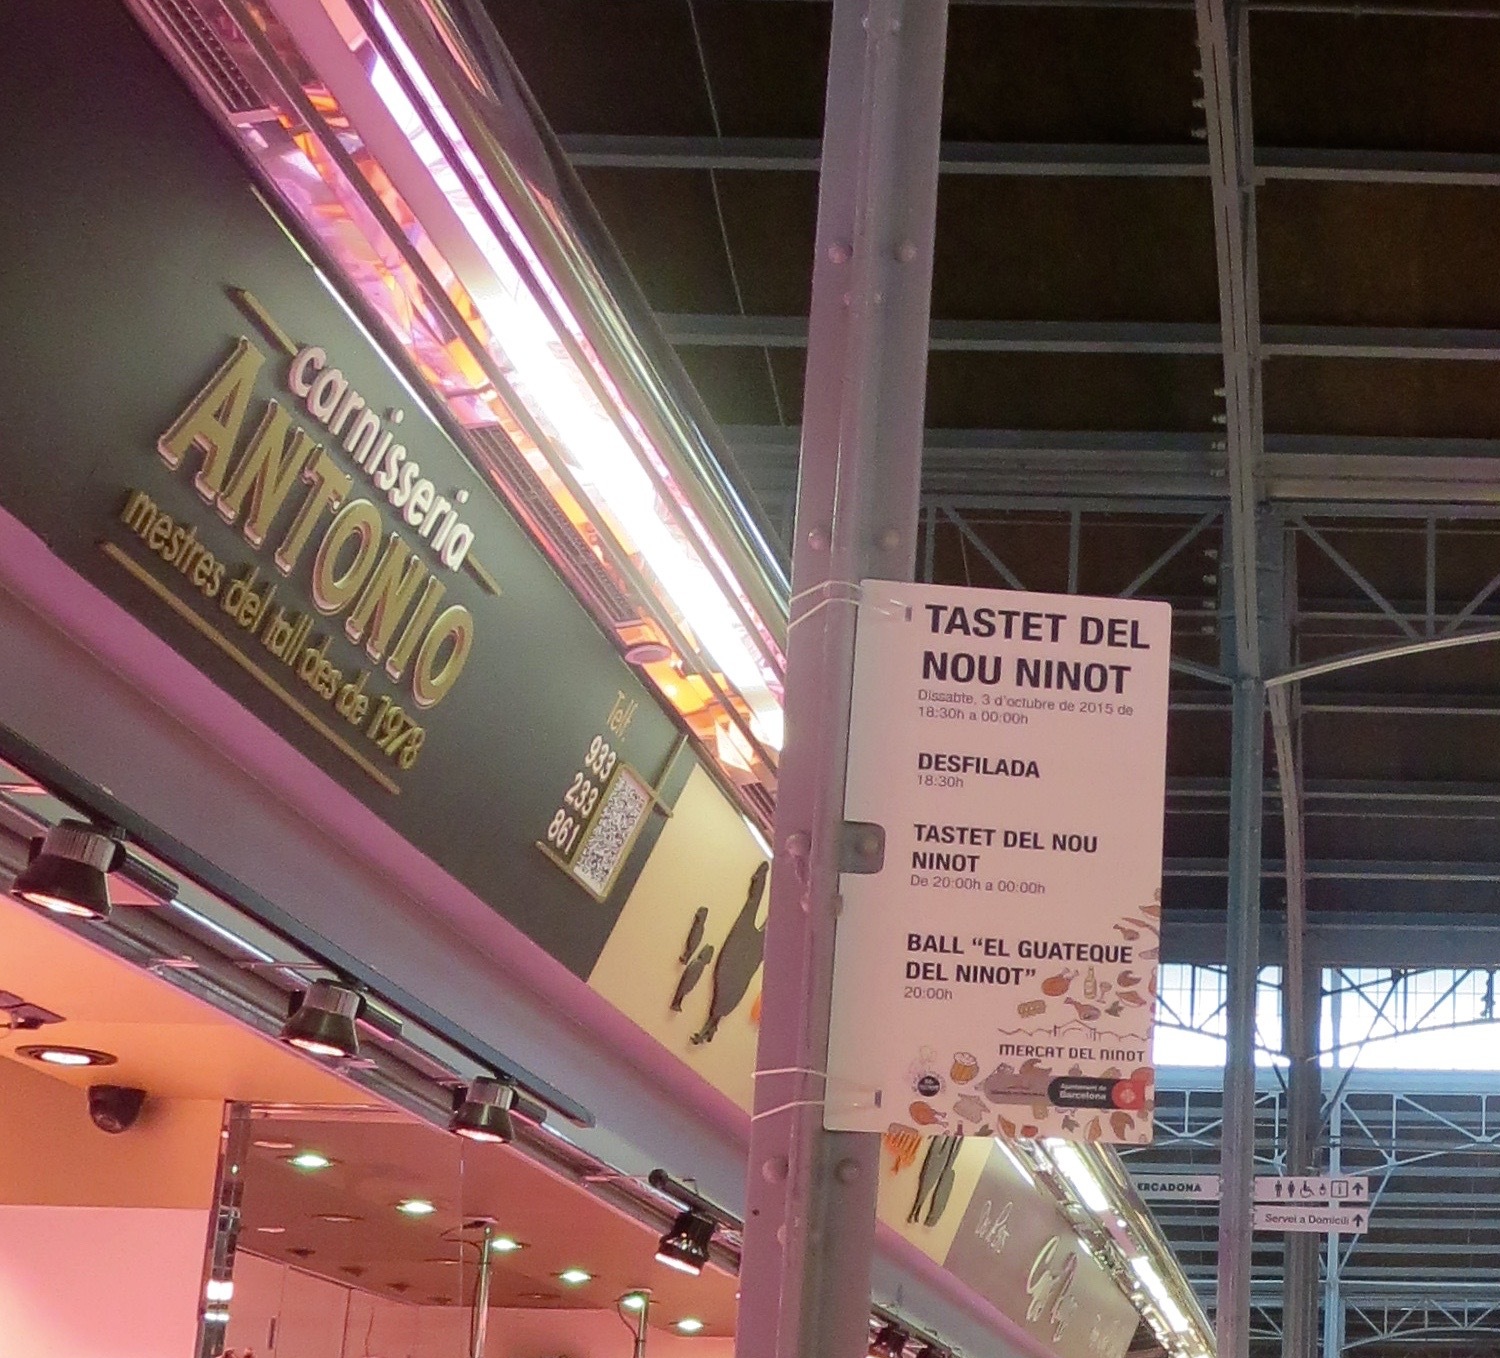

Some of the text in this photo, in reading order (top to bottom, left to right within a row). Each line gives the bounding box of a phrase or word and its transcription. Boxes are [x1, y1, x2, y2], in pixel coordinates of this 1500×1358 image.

[287, 345, 476, 572] carnisseria
[157, 335, 474, 710] ANTONIO
[120, 489, 426, 768] mestres del tall des de 1978
[925, 604, 1150, 649] TASTET DEL
[922, 650, 1132, 695] NOU NINOT
[918, 689, 977, 706] Dissabte,
[981, 693, 991, 705] 3
[1058, 699, 1075, 712] de
[1079, 700, 1114, 716] 2015
[1116, 703, 1134, 716] de
[918, 706, 1029, 725] 18:30h a 00:00h
[585, 735, 617, 782] 933
[918, 752, 1040, 779] DESFILADA
[917, 774, 965, 789] 18:30h
[563, 772, 599, 819] 233
[547, 808, 582, 855] 861
[913, 823, 1098, 853] TASTET DEL NOU
[911, 851, 980, 873] NINOT
[910, 874, 1046, 895] De 20:00h a 00:00h
[906, 933, 965, 955] BALL
[1017, 940, 1133, 964] GUATEQUE
[905, 961, 949, 982] DEL
[904, 986, 953, 1001] 20:00h
[999, 1043, 1146, 1063] MERCAT DEL NINOT
[1059, 1091, 1107, 1102] Barcelona
[1137, 1182, 1202, 1193] ERCADONA
